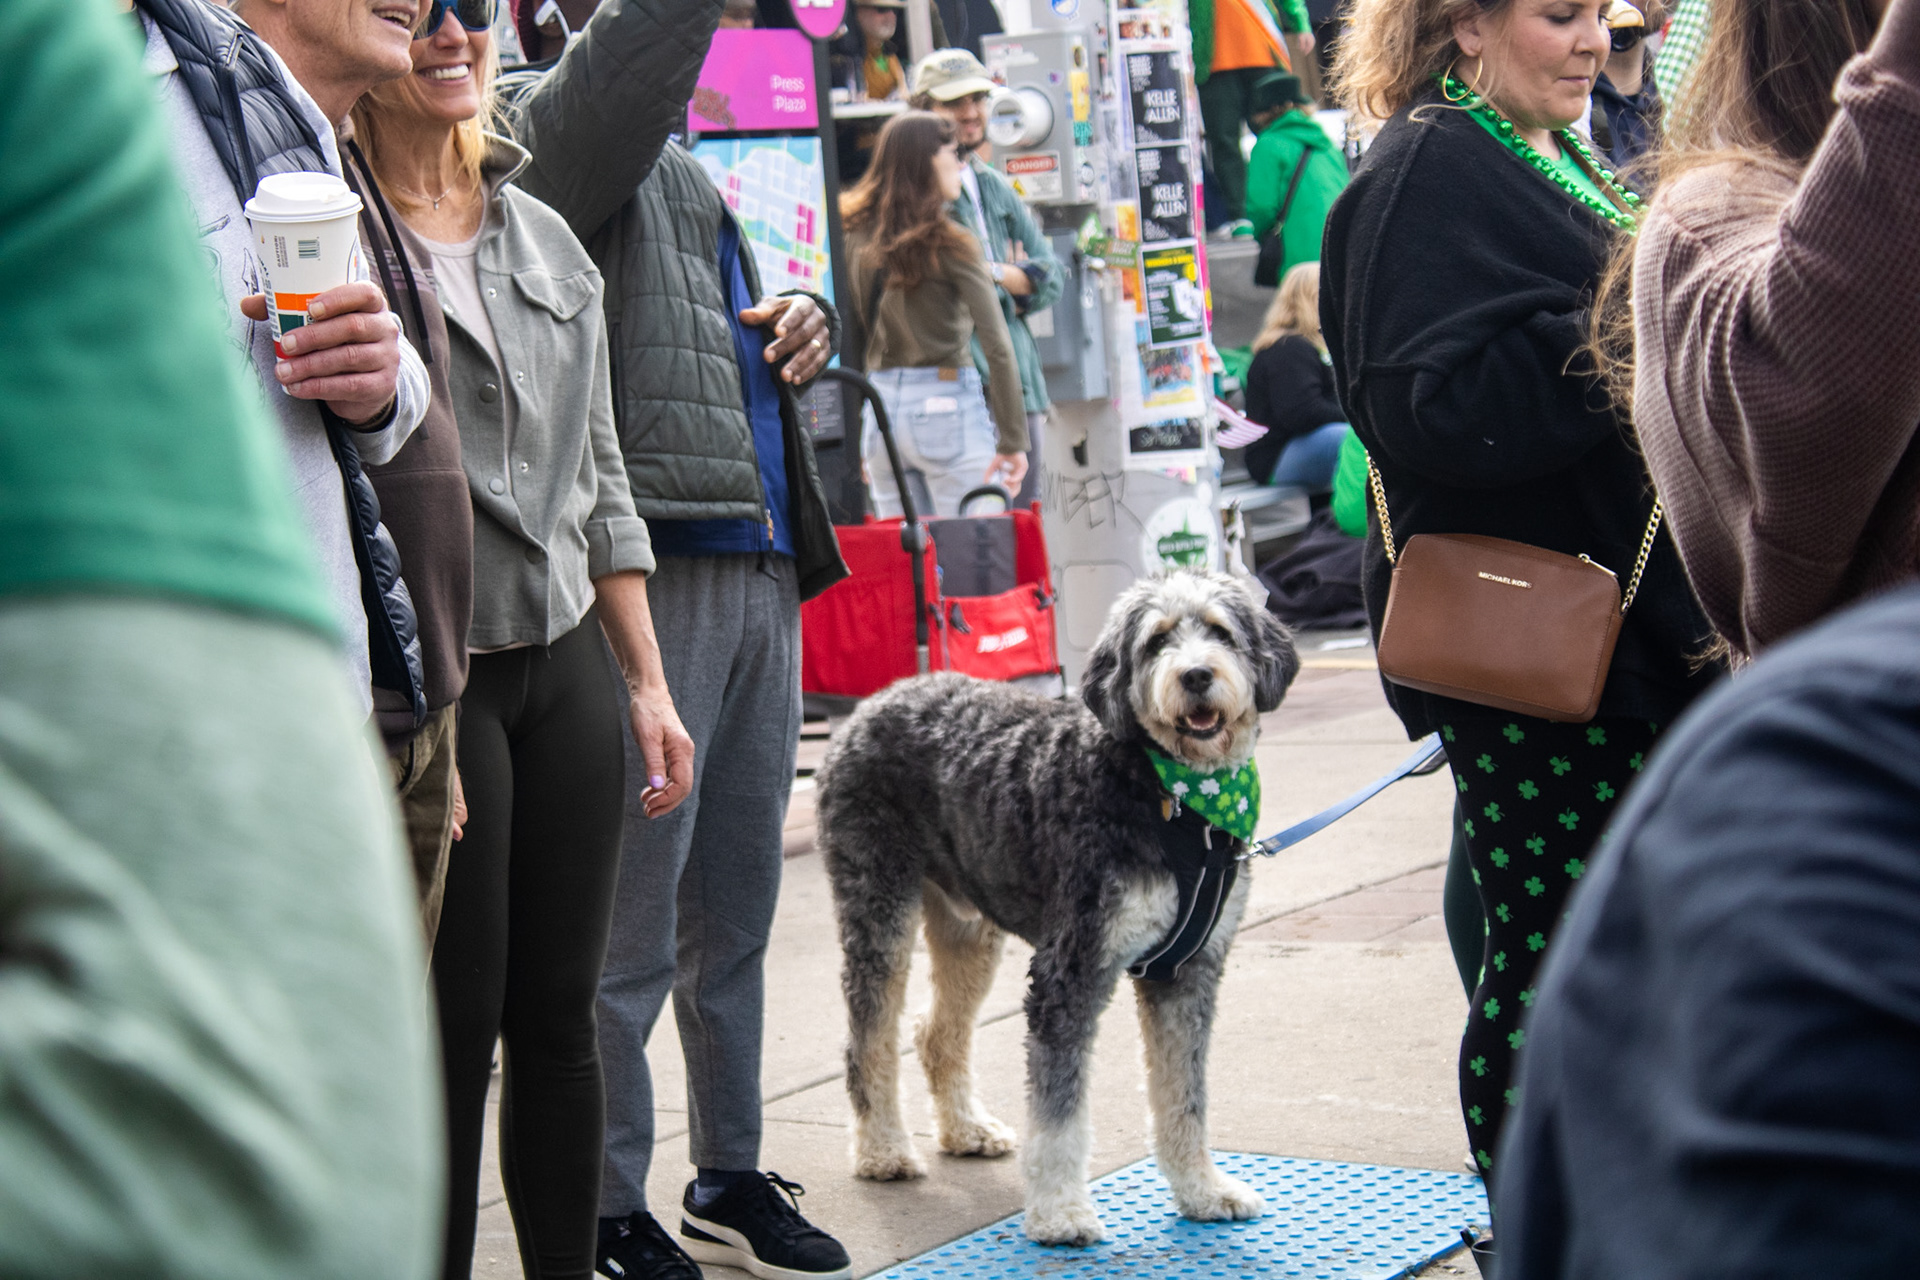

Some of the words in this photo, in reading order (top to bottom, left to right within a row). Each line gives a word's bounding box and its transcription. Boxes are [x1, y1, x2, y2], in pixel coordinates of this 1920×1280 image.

[770, 75, 805, 92] Press
[773, 95, 807, 113] Plaza
[1144, 106, 1180, 124] ALLEN
[1011, 157, 1053, 172] DANGER
[1152, 200, 1187, 218] ALLEN
[1478, 571, 1511, 585] MICHAEL
[1511, 578, 1533, 589] KORS
